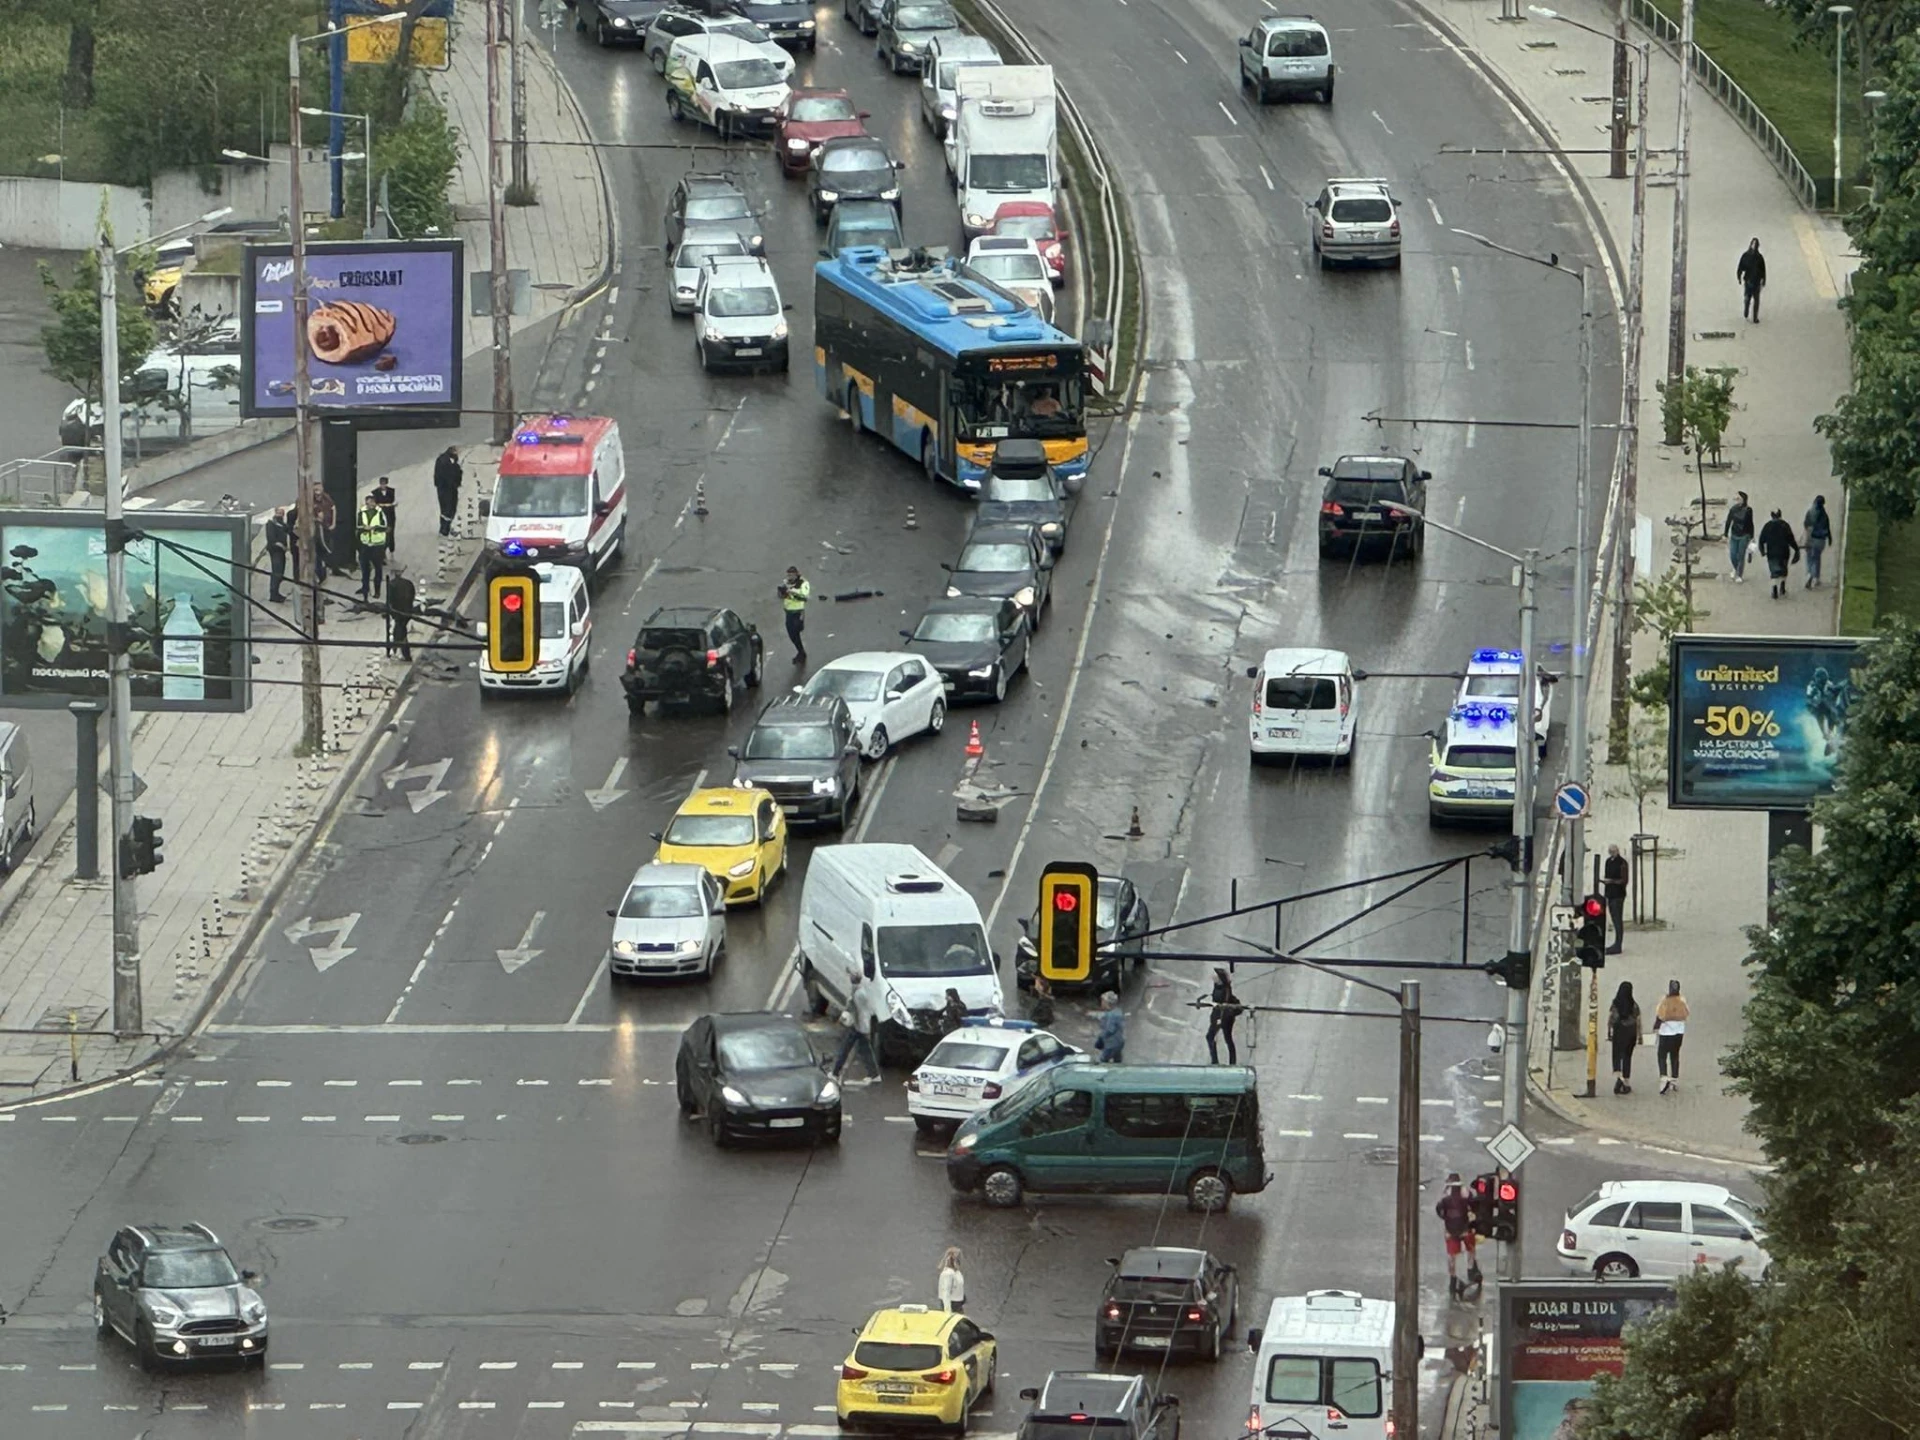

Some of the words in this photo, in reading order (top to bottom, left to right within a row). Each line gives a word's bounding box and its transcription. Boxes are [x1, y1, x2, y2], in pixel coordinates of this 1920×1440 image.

[339, 269, 404, 288] CROISSANT
[1695, 664, 1780, 683] unlimited
[1693, 705, 1781, 737] -50%
[1584, 1301, 1617, 1316] LIDL
